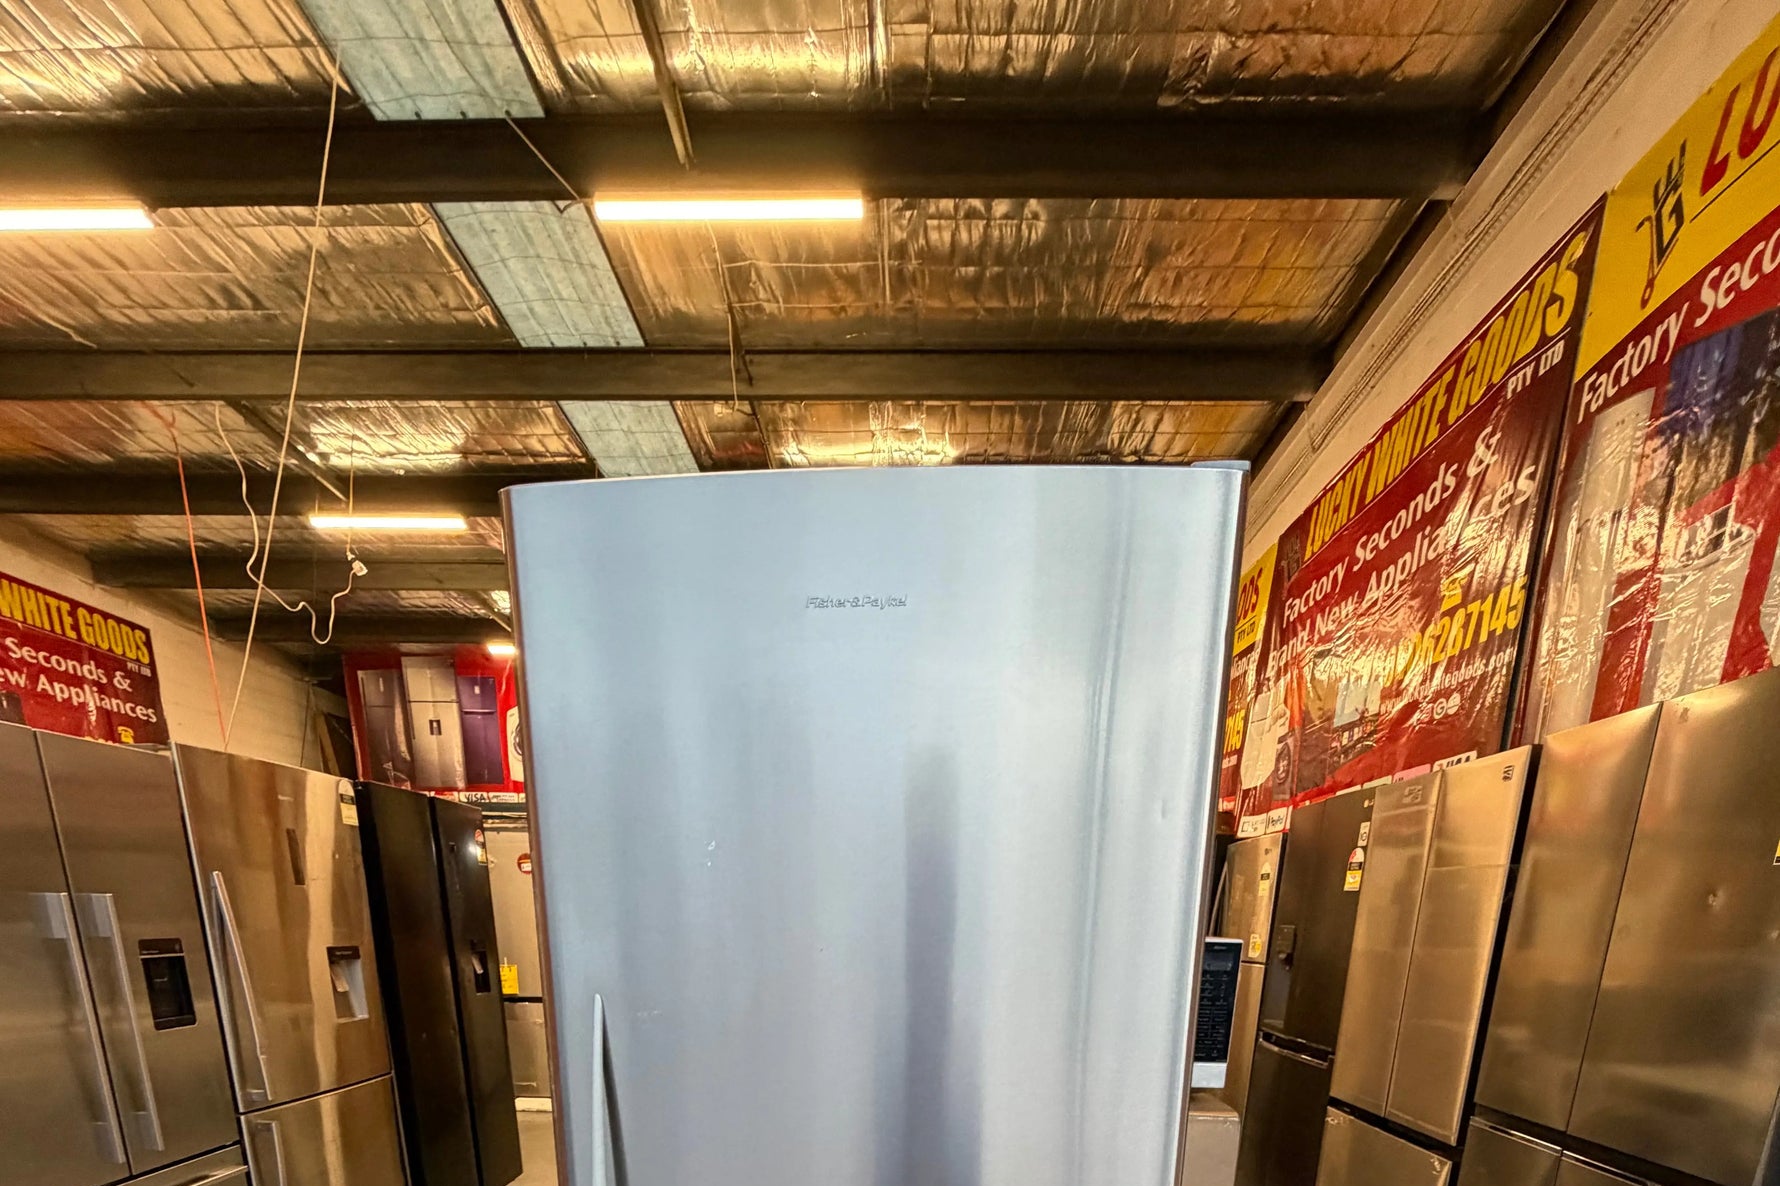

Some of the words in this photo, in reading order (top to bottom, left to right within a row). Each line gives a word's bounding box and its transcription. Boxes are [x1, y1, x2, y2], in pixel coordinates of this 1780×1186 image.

[1304, 451, 1372, 562] LUCKY
[1365, 363, 1456, 504] WHITE
[1447, 231, 1588, 425] GOODS
[1506, 362, 1535, 400] PTY
[1538, 340, 1565, 377] LTD
[1577, 301, 1690, 425] Factory
[1282, 555, 1349, 629] Factory
[1352, 461, 1459, 572] Seconds
[1466, 426, 1501, 479] &
[0, 578, 77, 640] WHITE
[77, 606, 150, 665] GOODS
[5, 636, 107, 684] Seconds
[113, 671, 133, 692] &
[1265, 618, 1311, 679] Brand
[1314, 591, 1359, 644] New
[36, 673, 157, 723] Appliances
[464, 793, 486, 802] VISA
